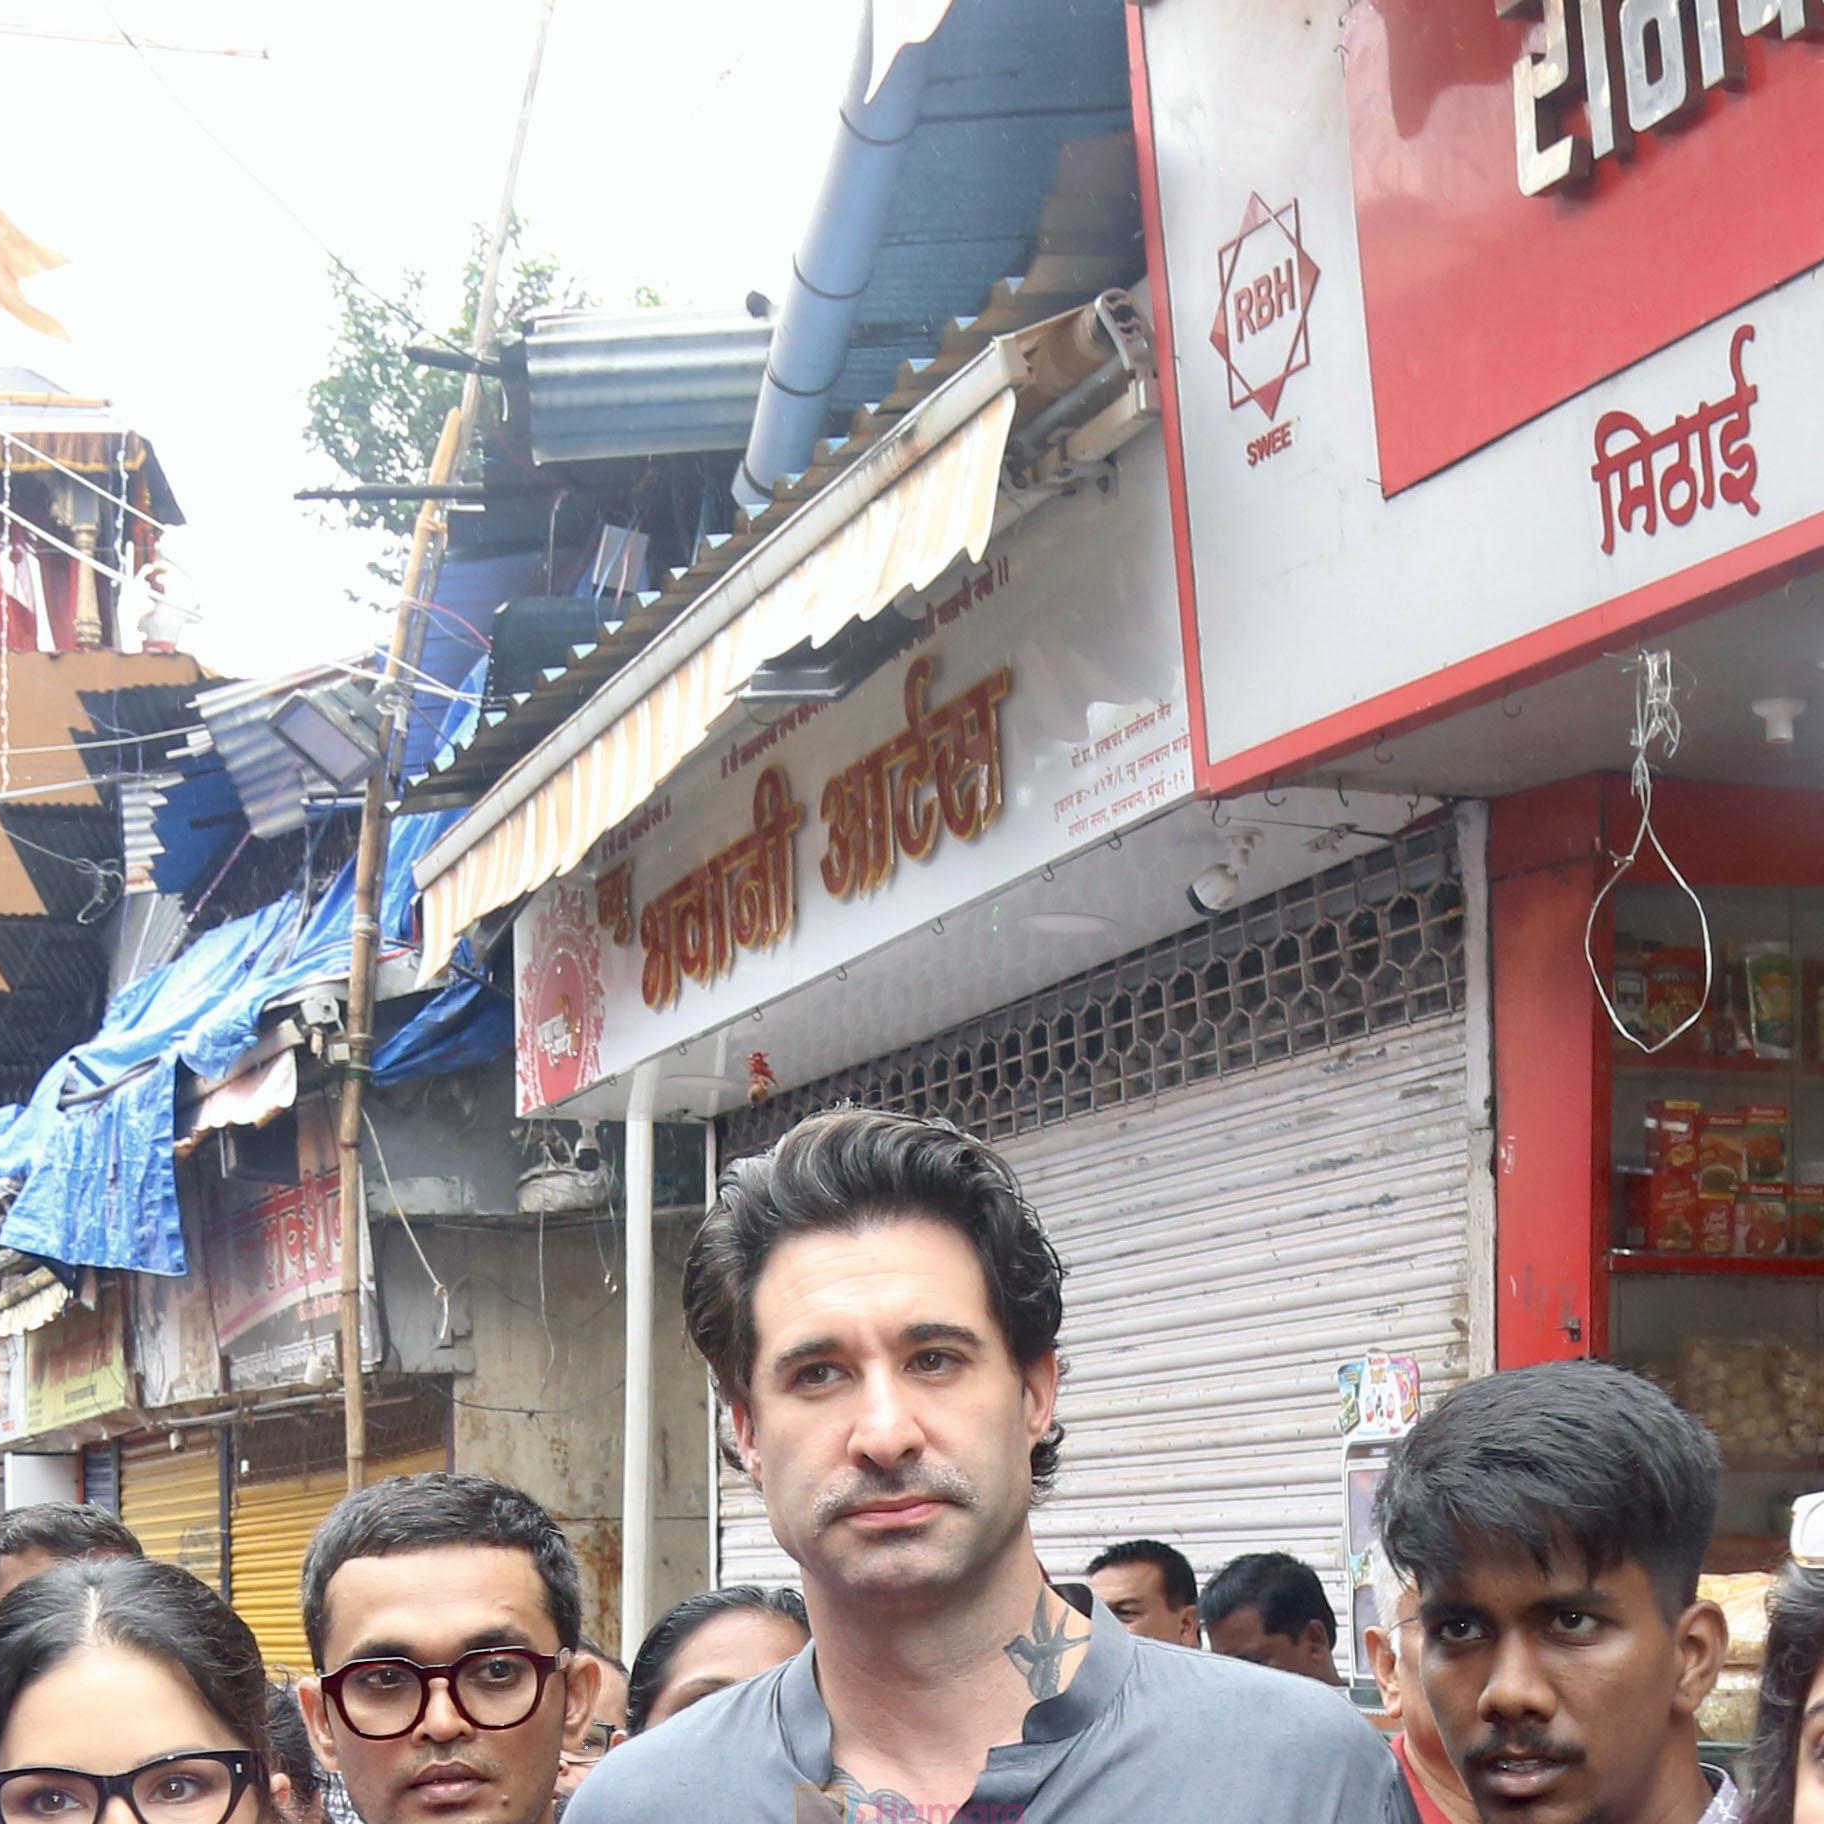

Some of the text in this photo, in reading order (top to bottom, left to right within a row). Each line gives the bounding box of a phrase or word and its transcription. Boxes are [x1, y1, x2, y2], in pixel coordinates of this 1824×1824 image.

[1233, 258, 1296, 343] RBH
[1593, 324, 1760, 556] मिठाई
[640, 766, 804, 1010] भवानी
